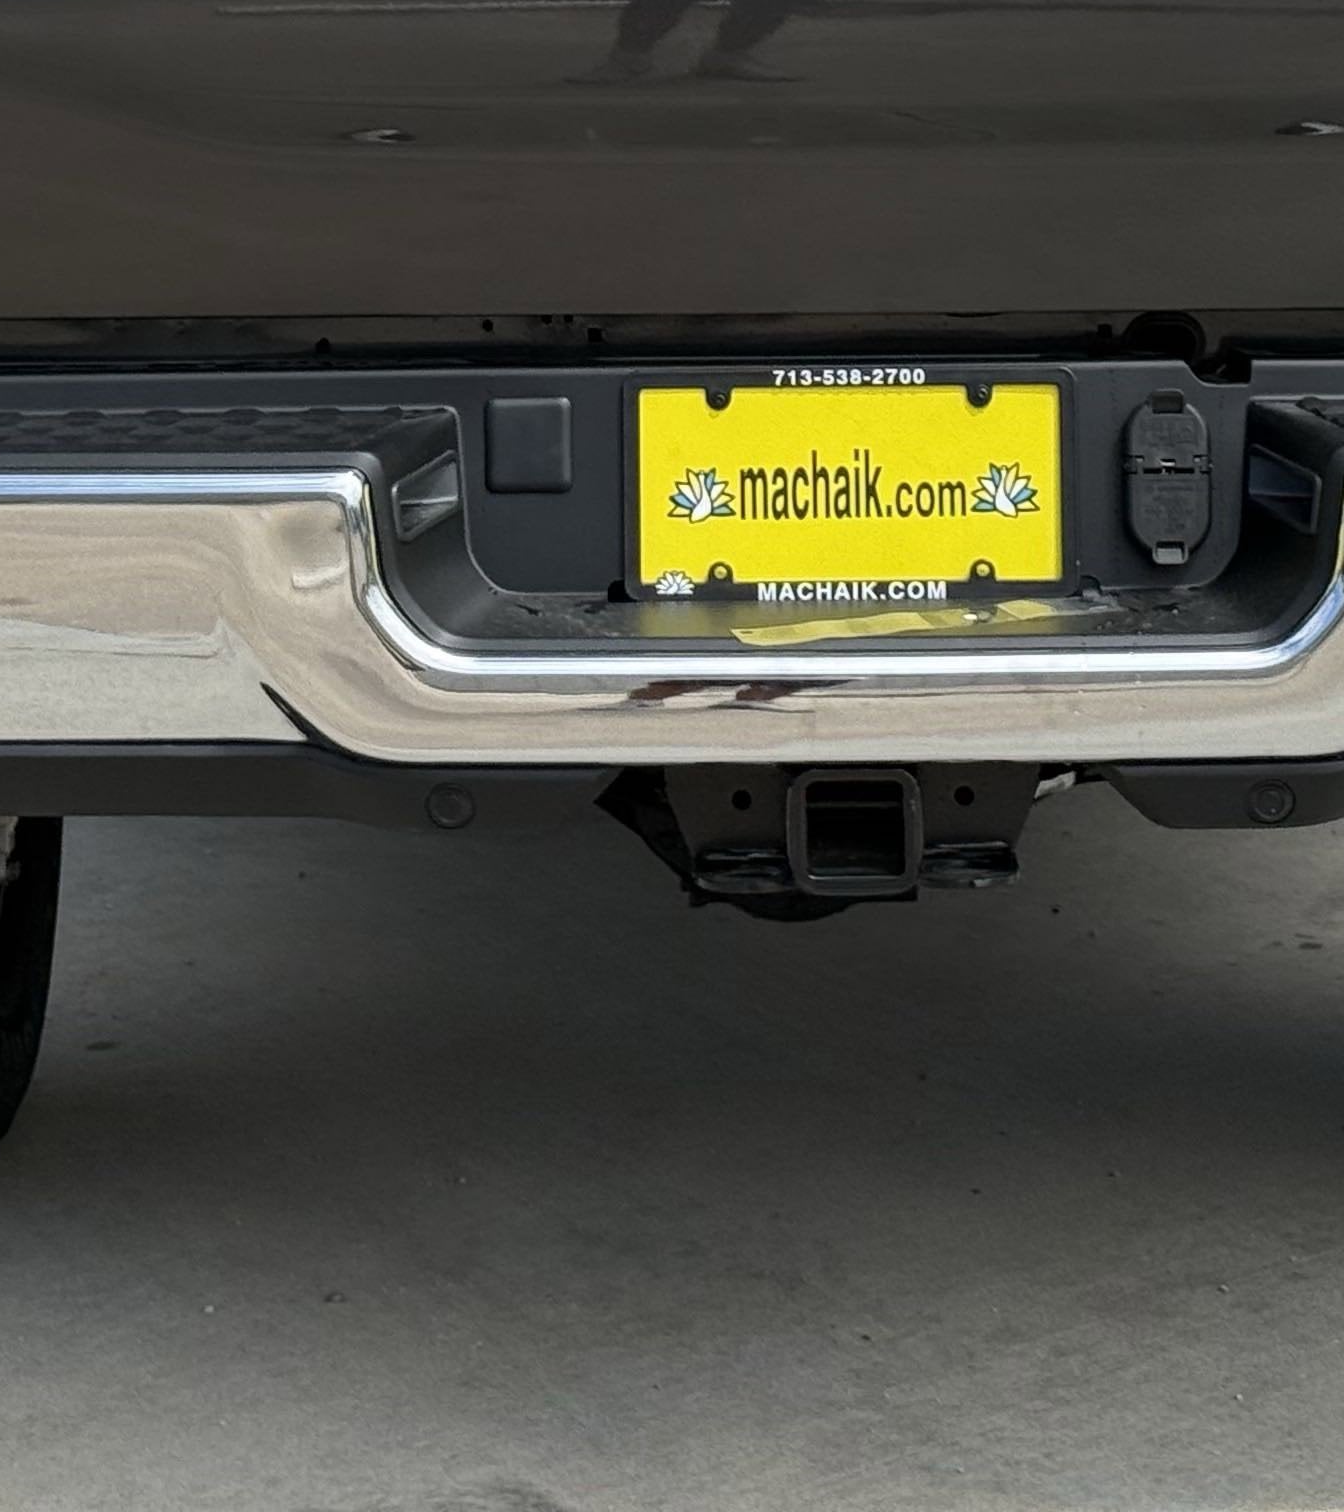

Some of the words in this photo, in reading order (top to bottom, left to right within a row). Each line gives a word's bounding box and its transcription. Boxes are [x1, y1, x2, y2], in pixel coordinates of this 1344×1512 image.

[772, 368, 926, 386] 713-538-2700
[740, 449, 967, 520] machaik.com
[757, 581, 947, 601] MACHAIK.COM
